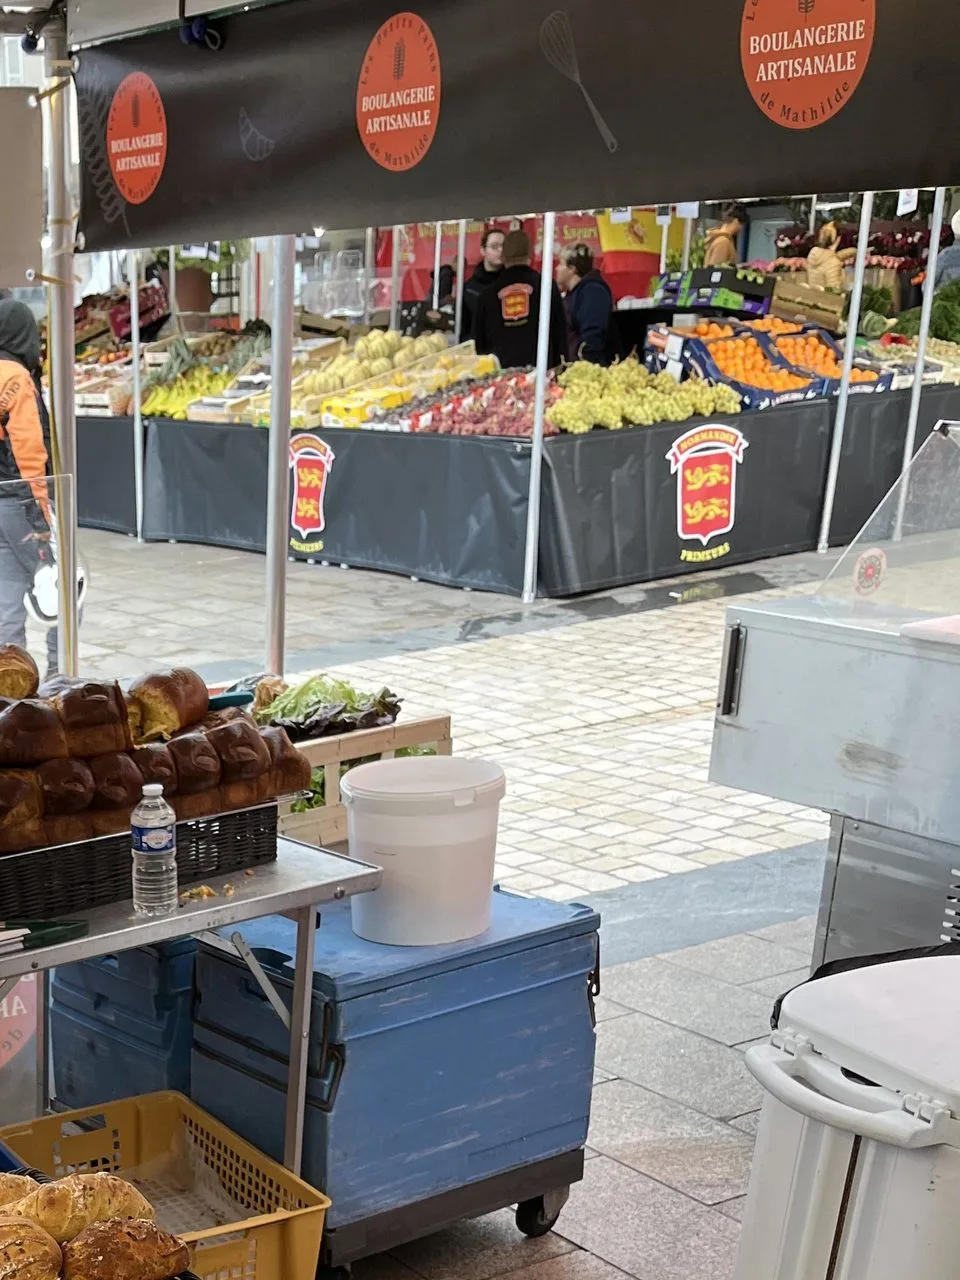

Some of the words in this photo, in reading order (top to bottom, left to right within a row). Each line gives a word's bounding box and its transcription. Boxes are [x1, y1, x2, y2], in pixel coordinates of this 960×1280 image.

[748, 19, 866, 55] BOULANGERIE
[755, 50, 858, 83] ARTISANALE
[361, 85, 436, 113] BOULANGERIE
[759, 91, 775, 110] de
[779, 81, 850, 122] Mathilde
[365, 109, 432, 135] ARTISANALE
[110, 132, 165, 155] BOULANGERIE
[369, 141, 381, 156] de
[383, 133, 430, 166] Mathilde
[115, 151, 161, 173] ARTISANALE
[679, 542, 731, 563] PRIMEURS
